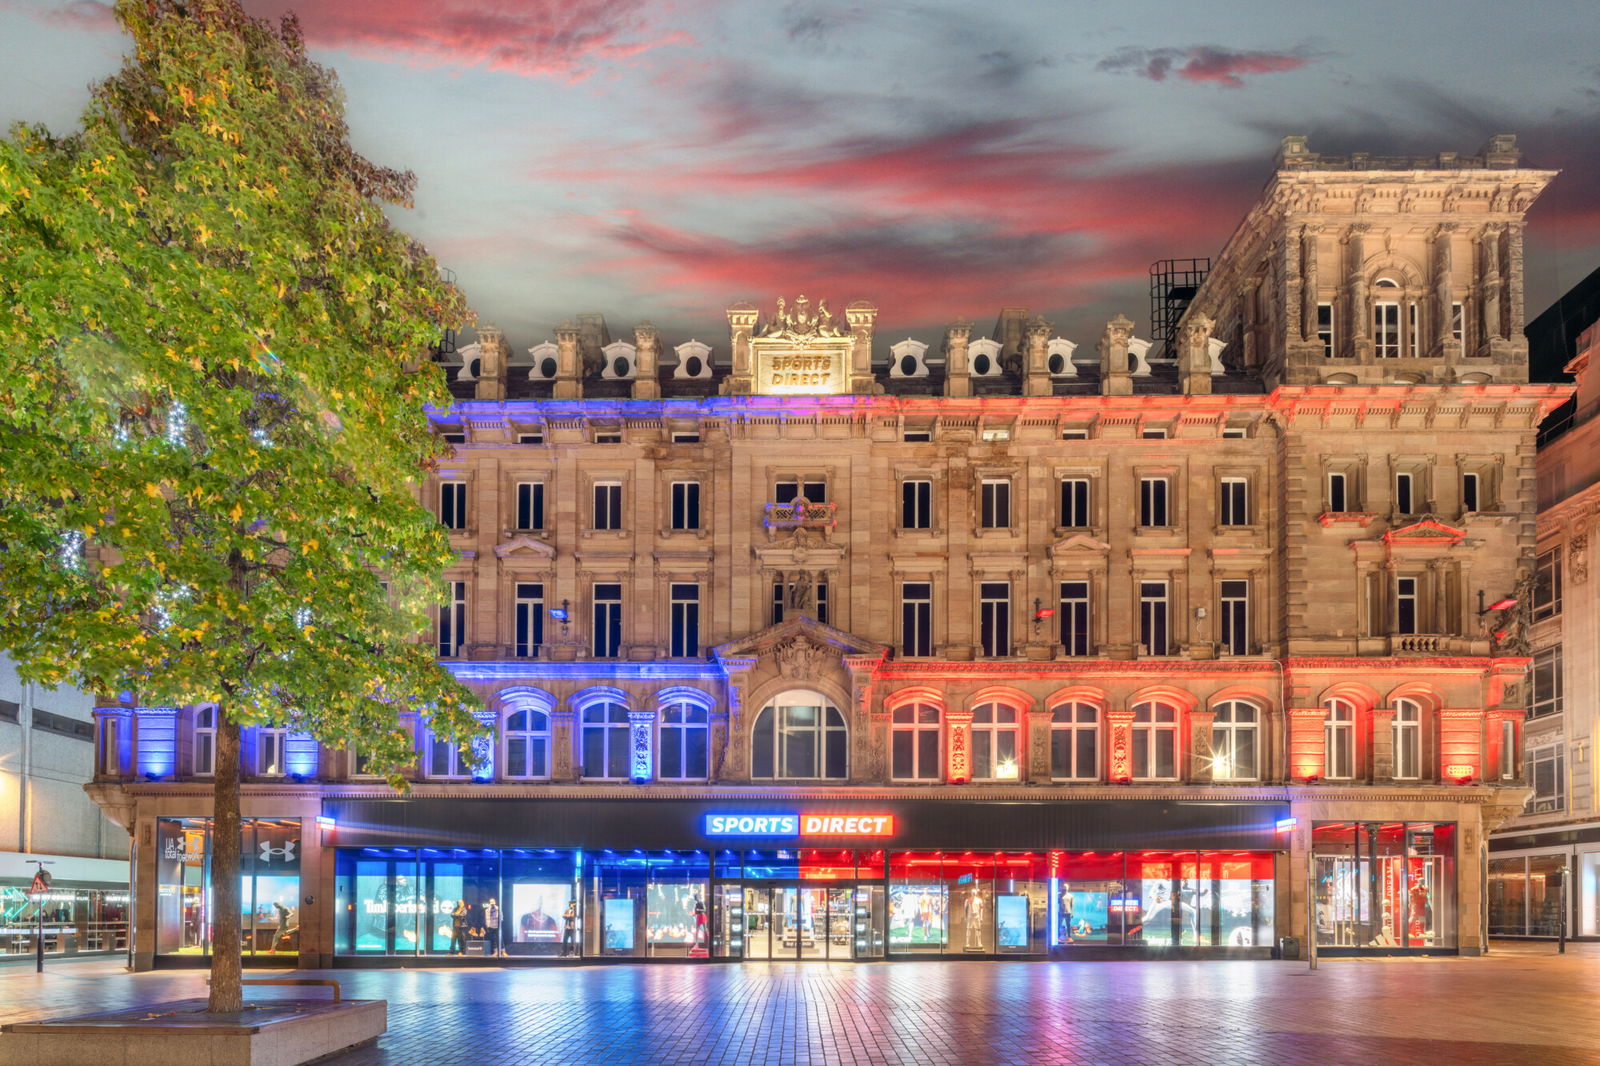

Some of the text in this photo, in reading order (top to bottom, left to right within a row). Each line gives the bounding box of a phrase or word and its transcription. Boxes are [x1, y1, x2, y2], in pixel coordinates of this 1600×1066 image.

[772, 356, 831, 372] SPORTS
[772, 373, 830, 386] DIRECT
[712, 817, 887, 833] SPORTS DIRECT
